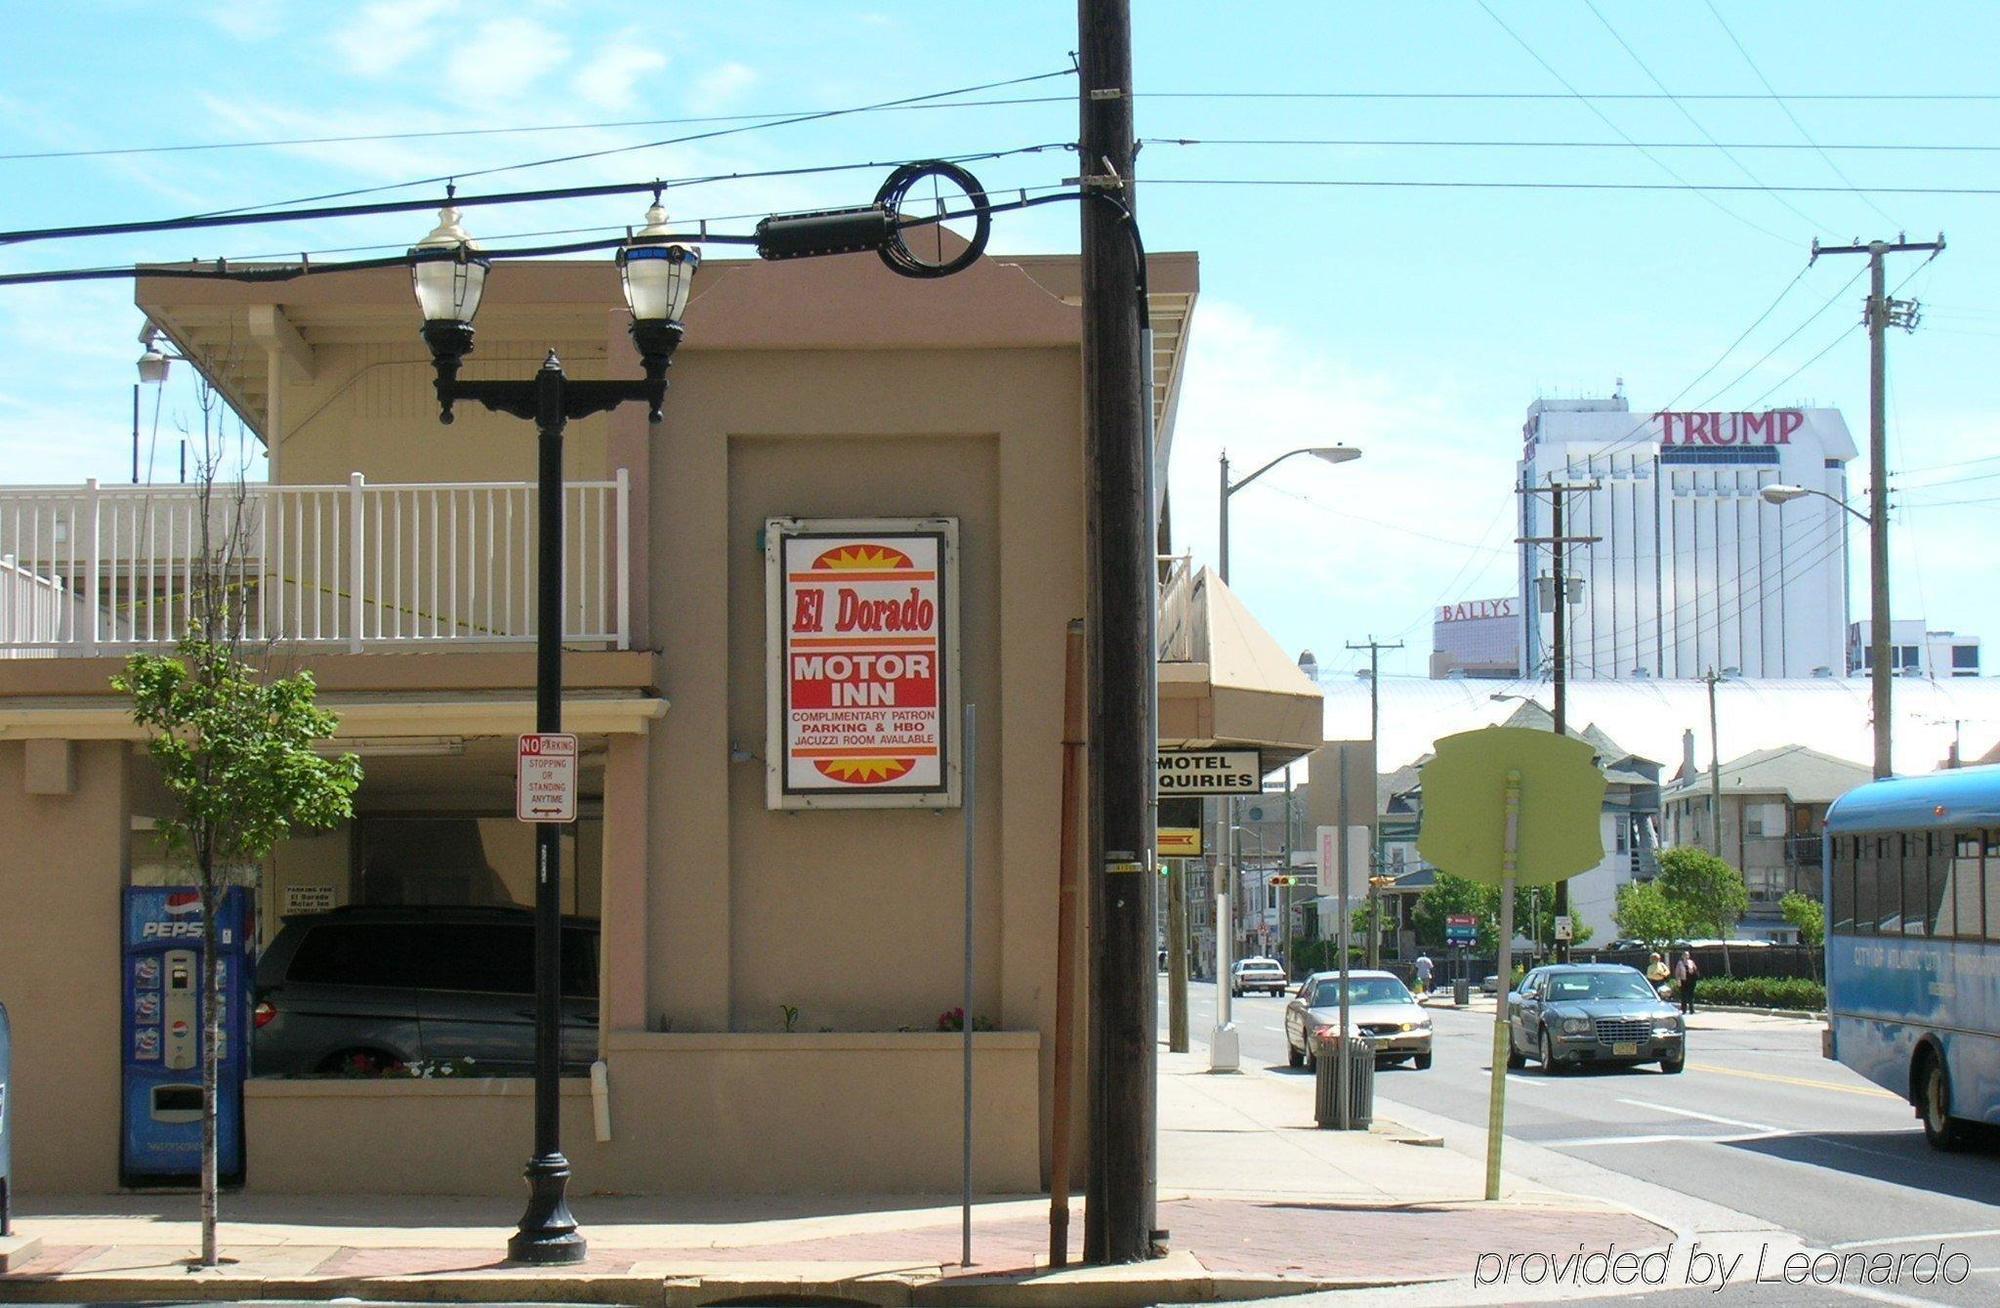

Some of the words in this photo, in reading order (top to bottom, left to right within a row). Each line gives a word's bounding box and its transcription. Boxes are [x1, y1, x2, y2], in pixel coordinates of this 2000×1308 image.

[1652, 411, 1804, 445] TRUMP
[792, 588, 824, 633] El
[835, 587, 934, 632] Dorado
[1442, 599, 1510, 622] BALLYS
[794, 655, 930, 680] MOTOR
[831, 682, 895, 706] INN
[792, 712, 886, 721] COMPLIMENTARY
[892, 711, 935, 720] PATRON
[802, 724, 867, 733] PARKING
[875, 723, 885, 732] &
[894, 722, 925, 732] HBO
[521, 738, 540, 753] NO
[542, 740, 574, 751] PARKING
[795, 736, 839, 746] JACUZZI
[843, 735, 875, 745] ROOM
[880, 735, 934, 744] AVAILABLE
[529, 759, 567, 769] STOPPING
[1158, 756, 1231, 769] MOTEL
[542, 771, 553, 780] OR
[1159, 773, 1253, 788] QUIRIES
[528, 782, 566, 792] STANDING
[532, 795, 563, 804] ANYTIME
[143, 922, 206, 938] PEPS
